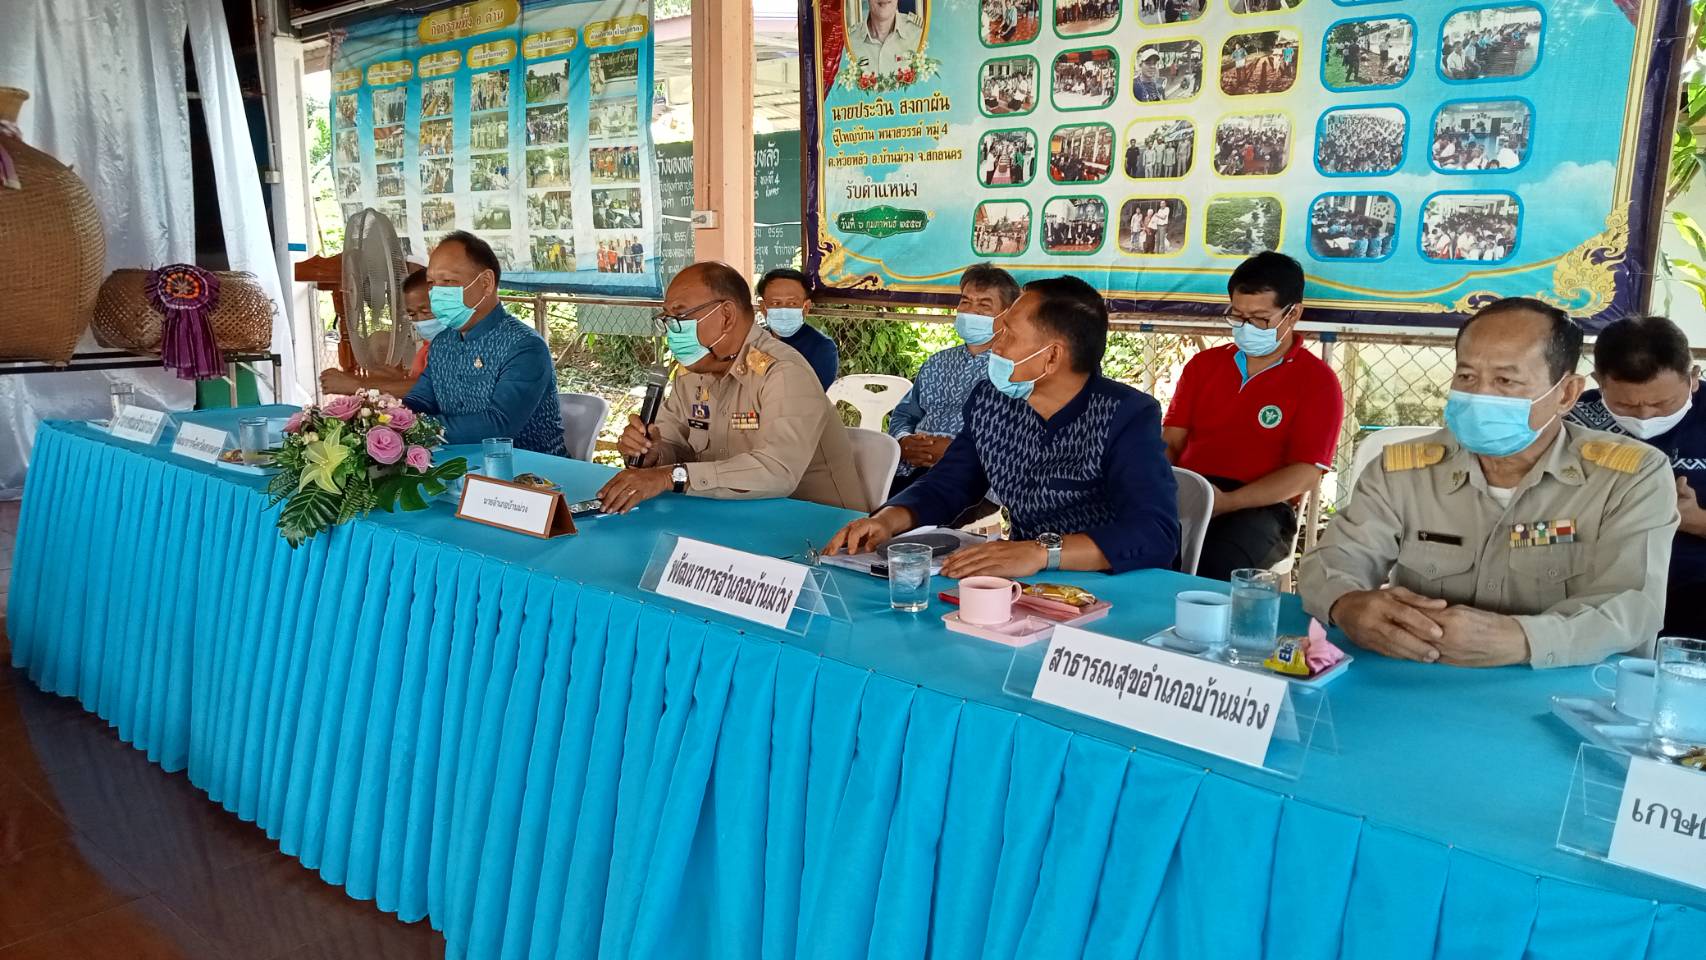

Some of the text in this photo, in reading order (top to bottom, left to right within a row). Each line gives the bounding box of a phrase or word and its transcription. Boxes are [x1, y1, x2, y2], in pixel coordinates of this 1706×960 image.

[832, 92, 951, 121] นายประวิน สงกาผัน
[832, 121, 948, 147] ผู้ใหญ่บ้าน พนาสวรรค์ หมู่ 4
[872, 148, 915, 164] อ.บ้านม่วง
[918, 149, 963, 162] จ.สกลนคร
[846, 174, 919, 200] รับตำแหน่ง
[840, 213, 856, 229] วันที่
[866, 215, 898, 232] กุมภาพันธ์
[667, 552, 794, 615] พัฒนาการอำเภอบ้านม่วง
[1048, 647, 1270, 730] สาธารณสุขอำเภอบ้านม่วง
